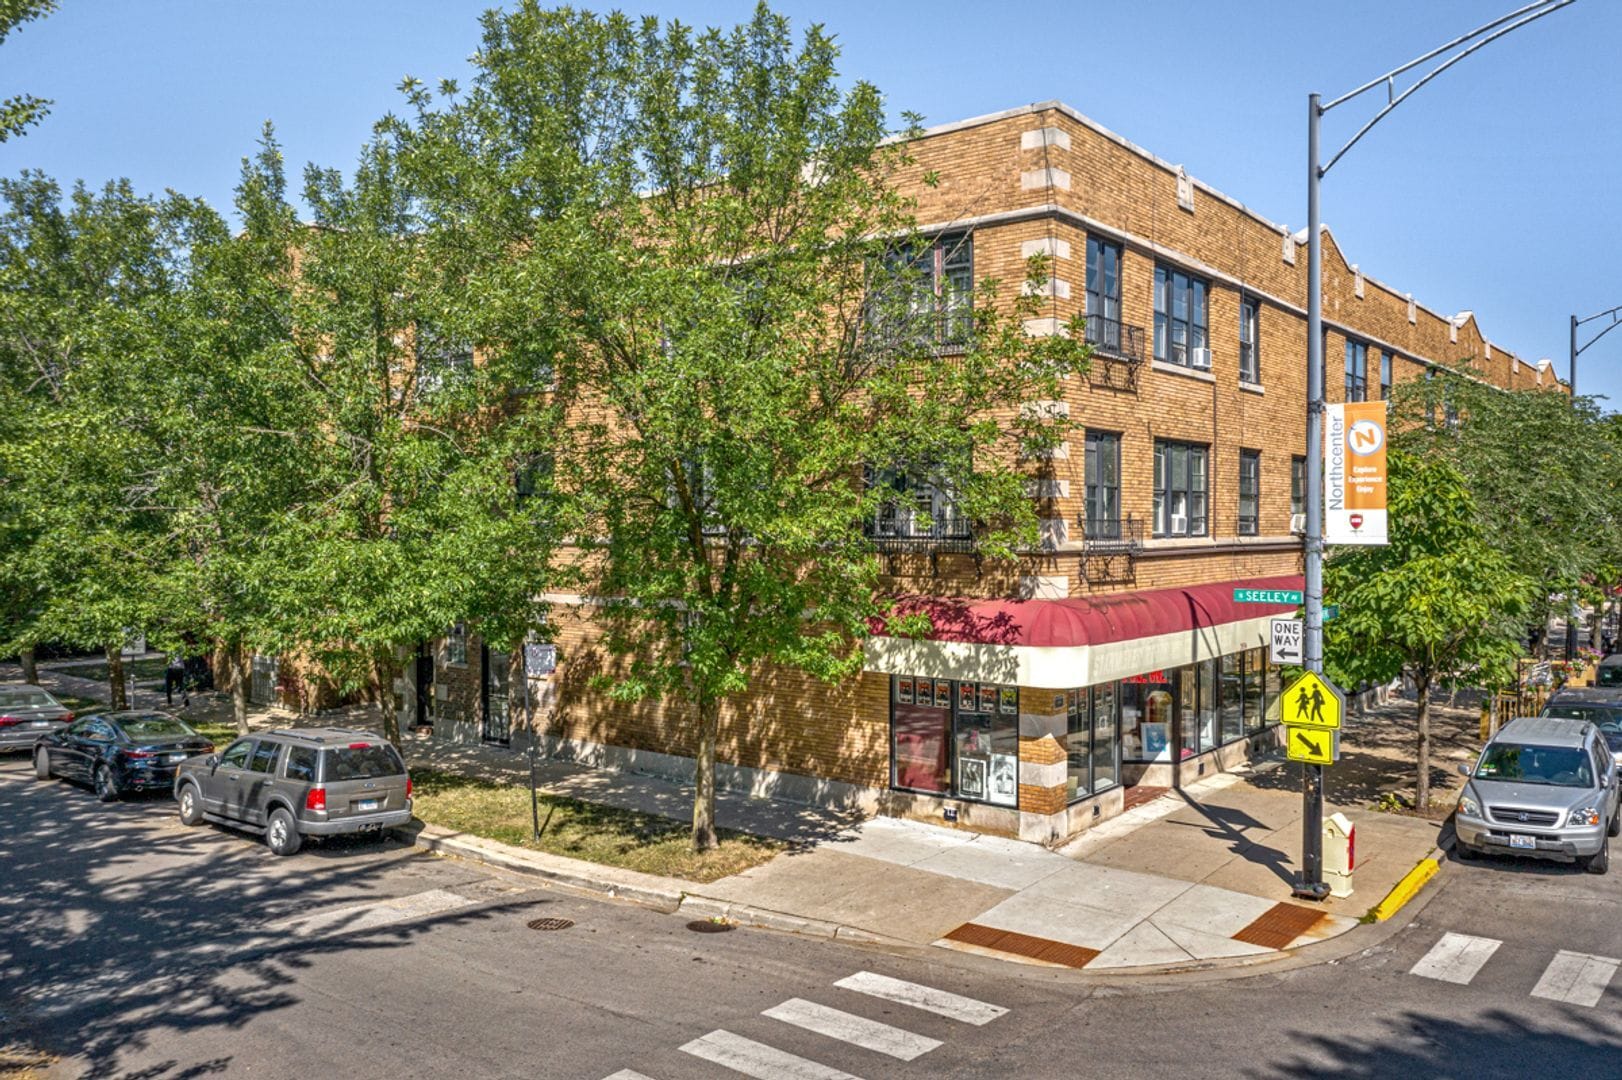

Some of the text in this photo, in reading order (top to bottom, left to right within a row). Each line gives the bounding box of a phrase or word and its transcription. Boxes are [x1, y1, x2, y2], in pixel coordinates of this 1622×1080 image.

[1355, 428, 1376, 448] N
[1329, 415, 1344, 511] Northcenter
[1246, 591, 1290, 602] SEELEY
[1274, 623, 1300, 635] ONE
[1274, 635, 1300, 647] WAY
